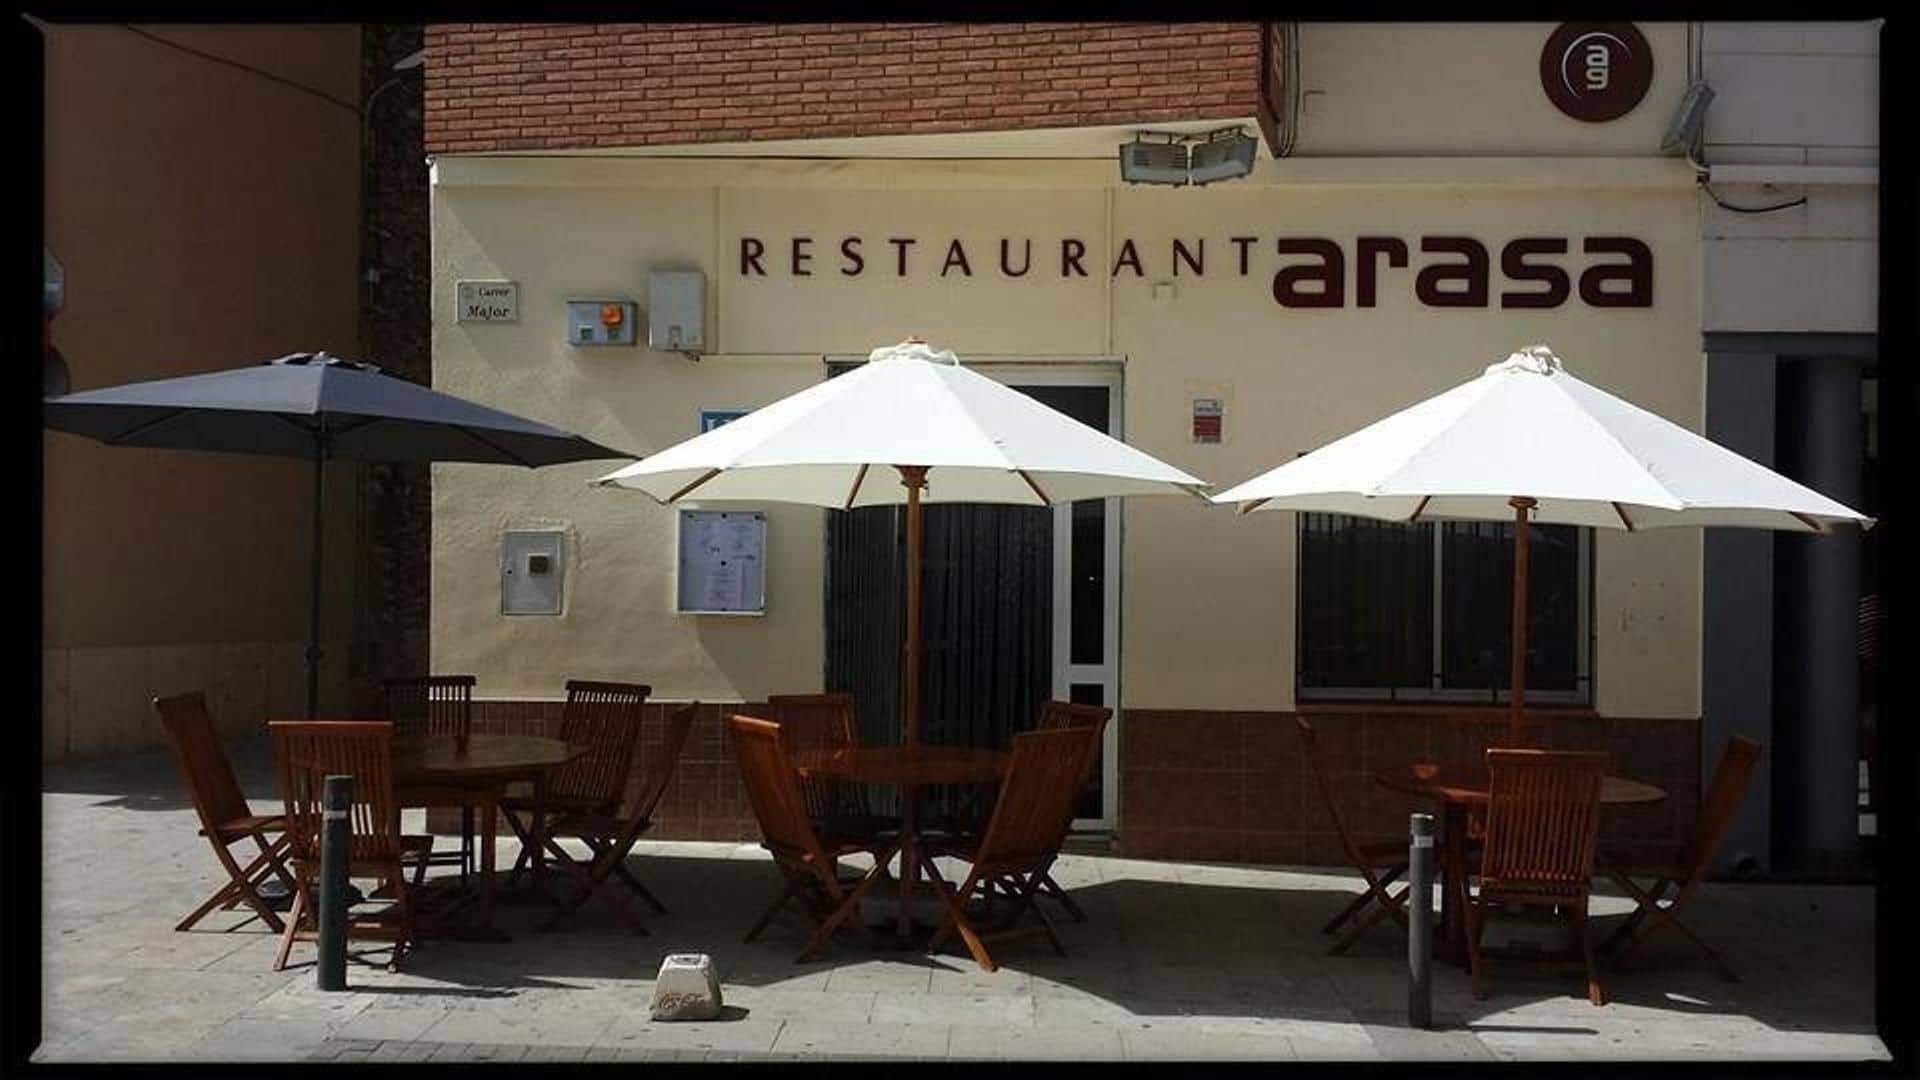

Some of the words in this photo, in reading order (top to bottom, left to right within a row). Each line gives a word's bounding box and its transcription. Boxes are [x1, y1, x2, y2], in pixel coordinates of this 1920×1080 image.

[740, 236, 1260, 278] RESTAURANT
[1272, 235, 1654, 309] arasa
[467, 304, 511, 320] Major
